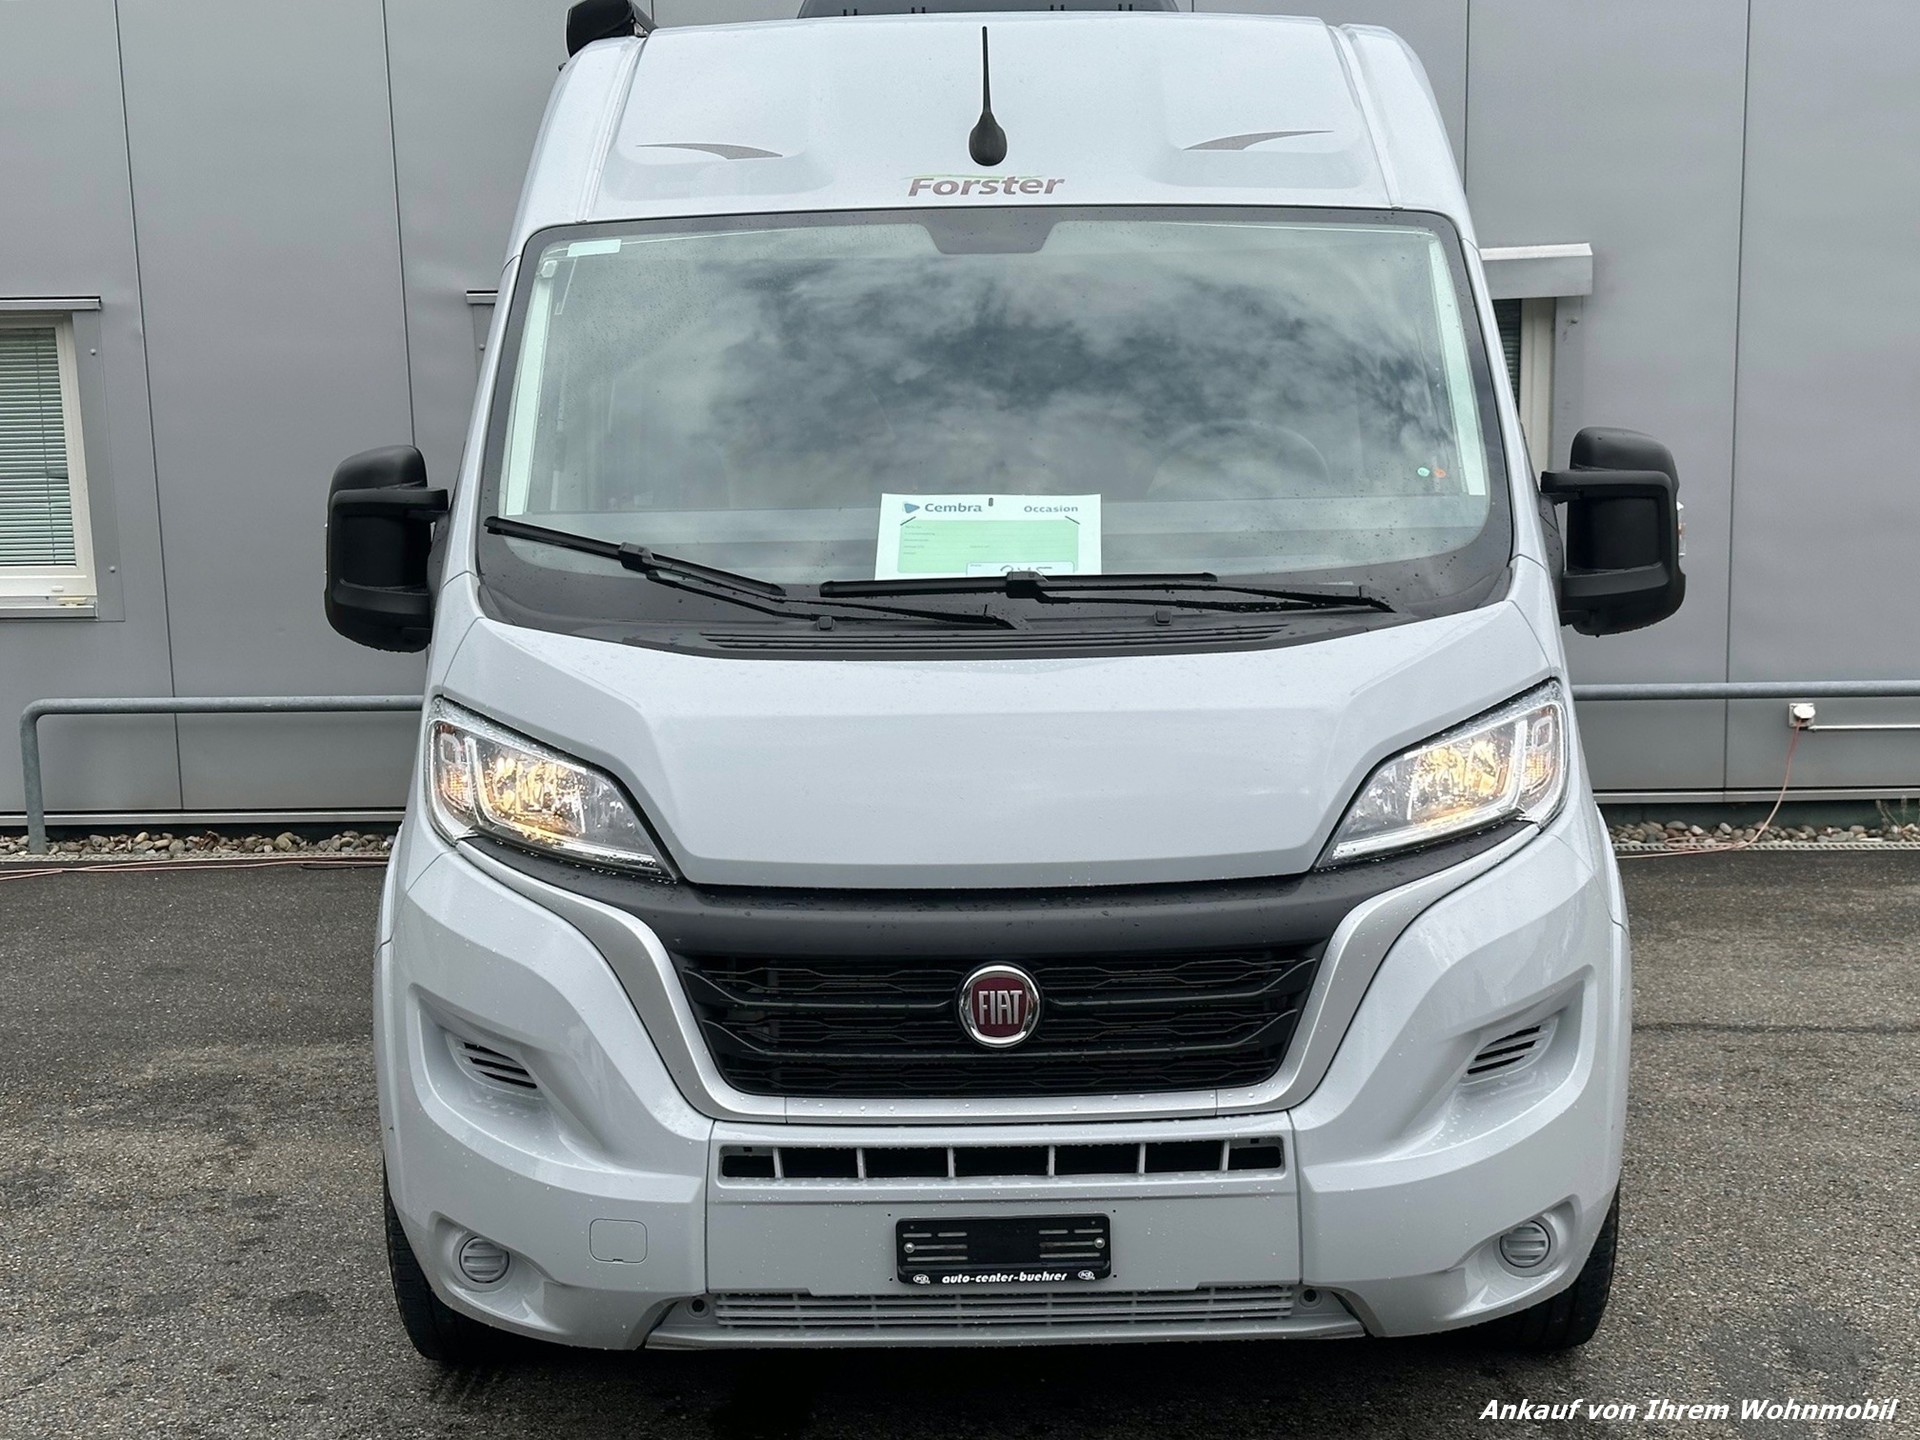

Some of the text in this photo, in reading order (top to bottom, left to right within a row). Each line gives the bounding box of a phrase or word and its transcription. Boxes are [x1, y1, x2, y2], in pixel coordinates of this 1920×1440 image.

[908, 176, 1066, 197] Forster
[924, 502, 983, 513] Cembra
[1023, 504, 1079, 513] Occasion
[978, 990, 1023, 1025] FIAT
[941, 1271, 1068, 1284] auto-center-buehrer
